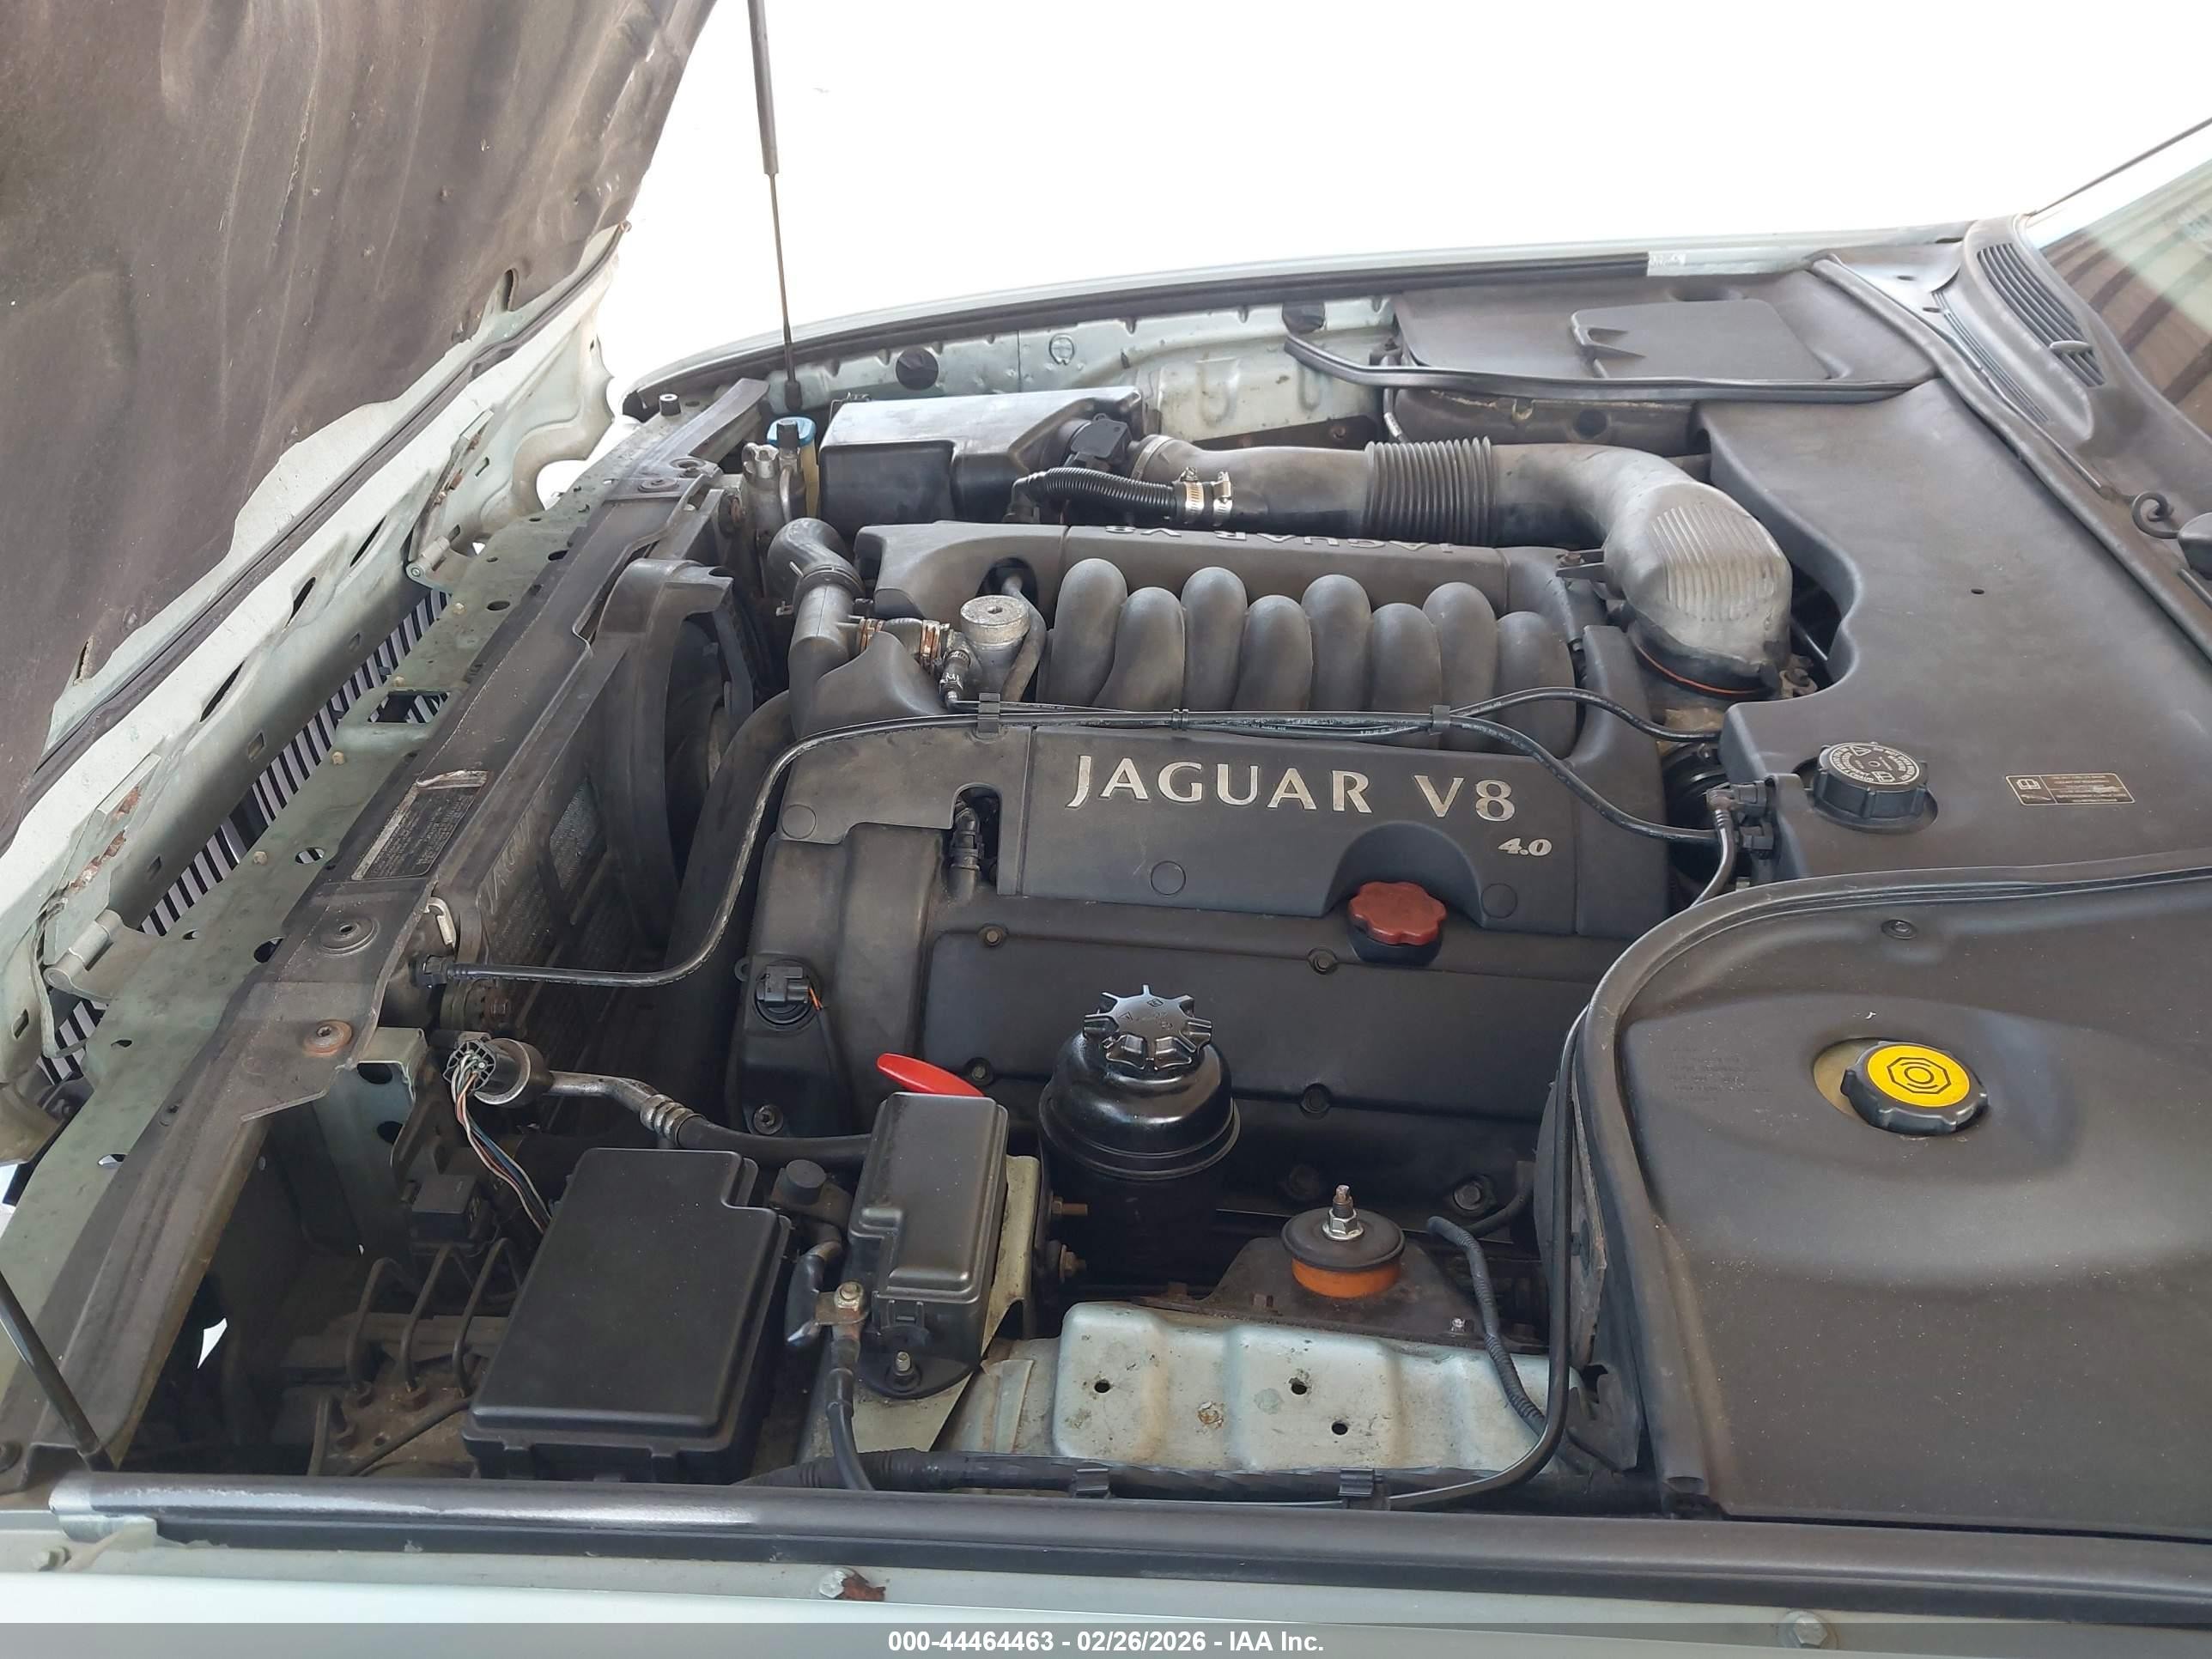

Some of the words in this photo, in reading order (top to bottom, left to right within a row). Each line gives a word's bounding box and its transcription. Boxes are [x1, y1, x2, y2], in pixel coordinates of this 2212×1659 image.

[1066, 755, 1372, 814] JAGUAR
[1414, 775, 1516, 822] V8
[1498, 837, 1553, 857] 4.0
